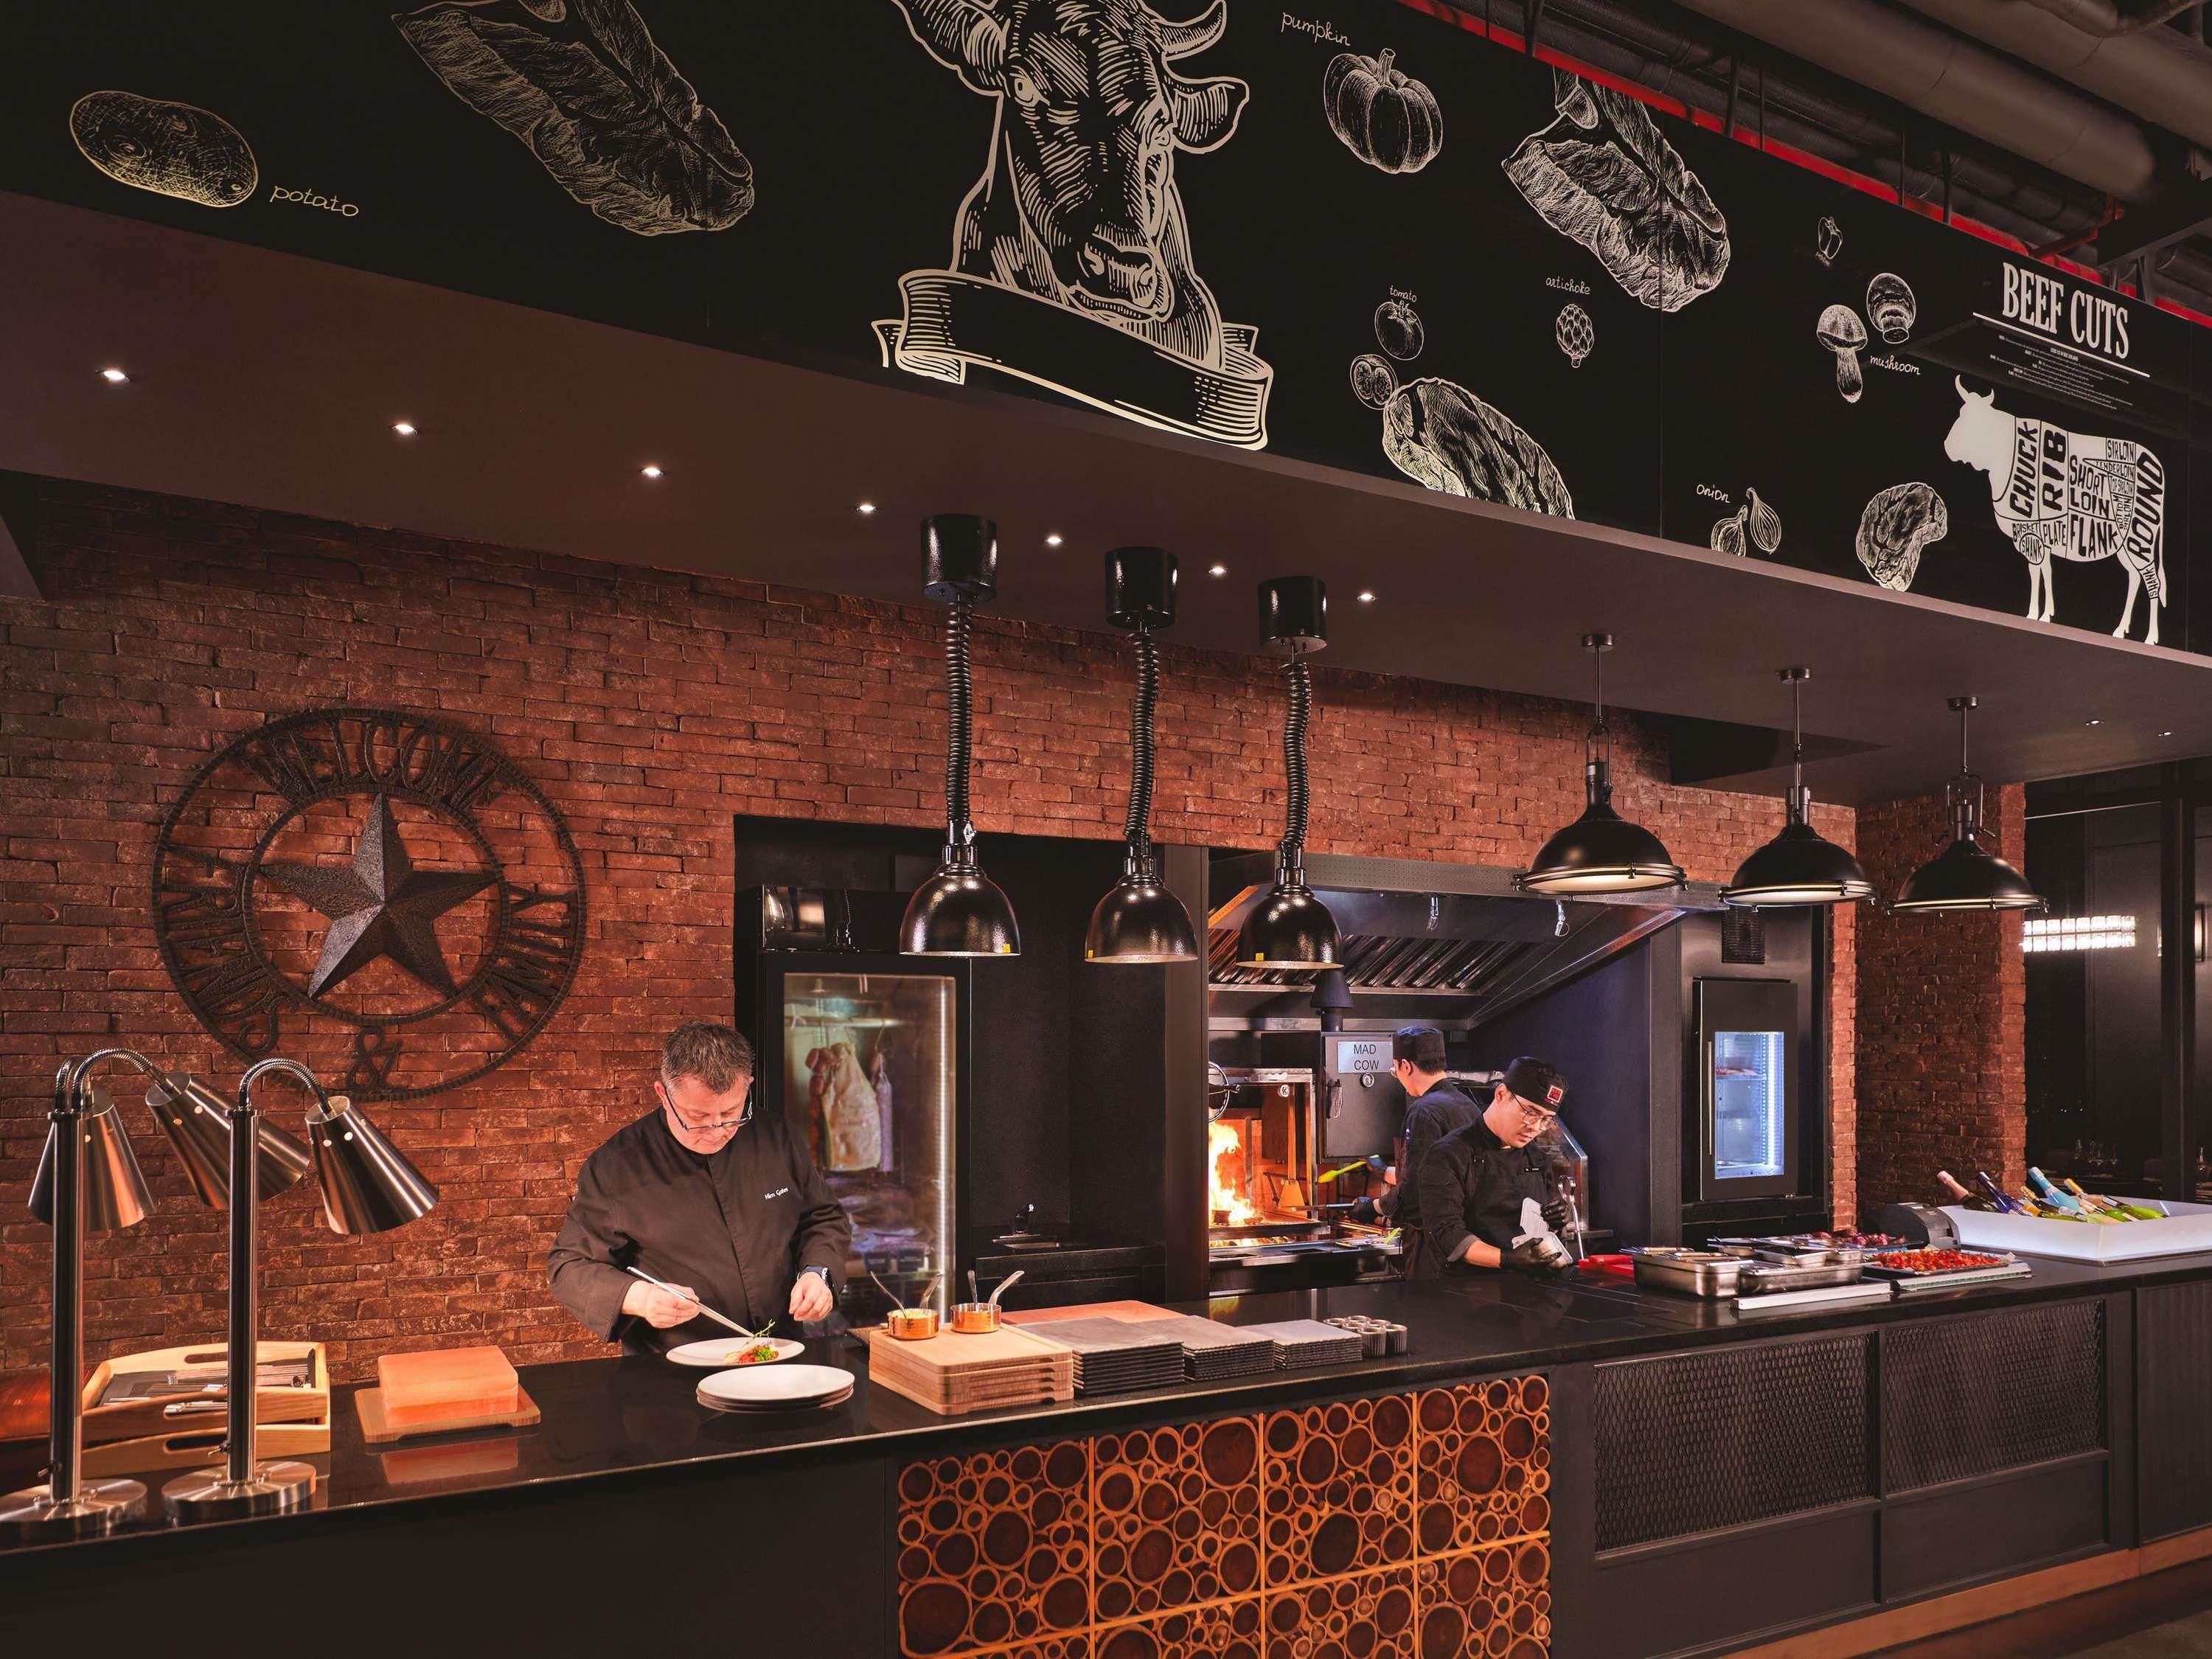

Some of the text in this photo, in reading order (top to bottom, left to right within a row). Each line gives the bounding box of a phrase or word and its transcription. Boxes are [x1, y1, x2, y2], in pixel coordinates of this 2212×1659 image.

[1281, 12, 1351, 46] pumpkin
[269, 185, 359, 217] potato
[1390, 285, 1417, 302] tomato
[1545, 275, 1591, 295] artichoke
[2002, 262, 2129, 359] BEEF CUTS
[1870, 355, 1921, 375] mushroom
[2107, 439, 2135, 462] SIRLOIN
[2010, 422, 2038, 518] CHUCK
[2042, 429, 2067, 511] RIB
[2070, 455, 2107, 495] SHORT
[2096, 461, 2135, 480] TENDERLOIN
[2070, 488, 2110, 520] LOIN
[2113, 495, 2124, 529] BOTTOM
[2124, 497, 2132, 530] SIRLOIN
[2126, 451, 2163, 563] ROUND
[2012, 523, 2039, 543] BRISKET
[2022, 536, 2042, 561] SHANK
[2042, 520, 2067, 546] PLATE
[2070, 514, 2118, 558] FLANK
[2143, 567, 2159, 598] SHANK
[240, 714, 509, 817] WELCOME
[160, 846, 296, 1052] FRIENDS
[346, 1025, 403, 1092] &
[1354, 1044, 1377, 1054] MAD
[1354, 1060, 1379, 1071] COW
